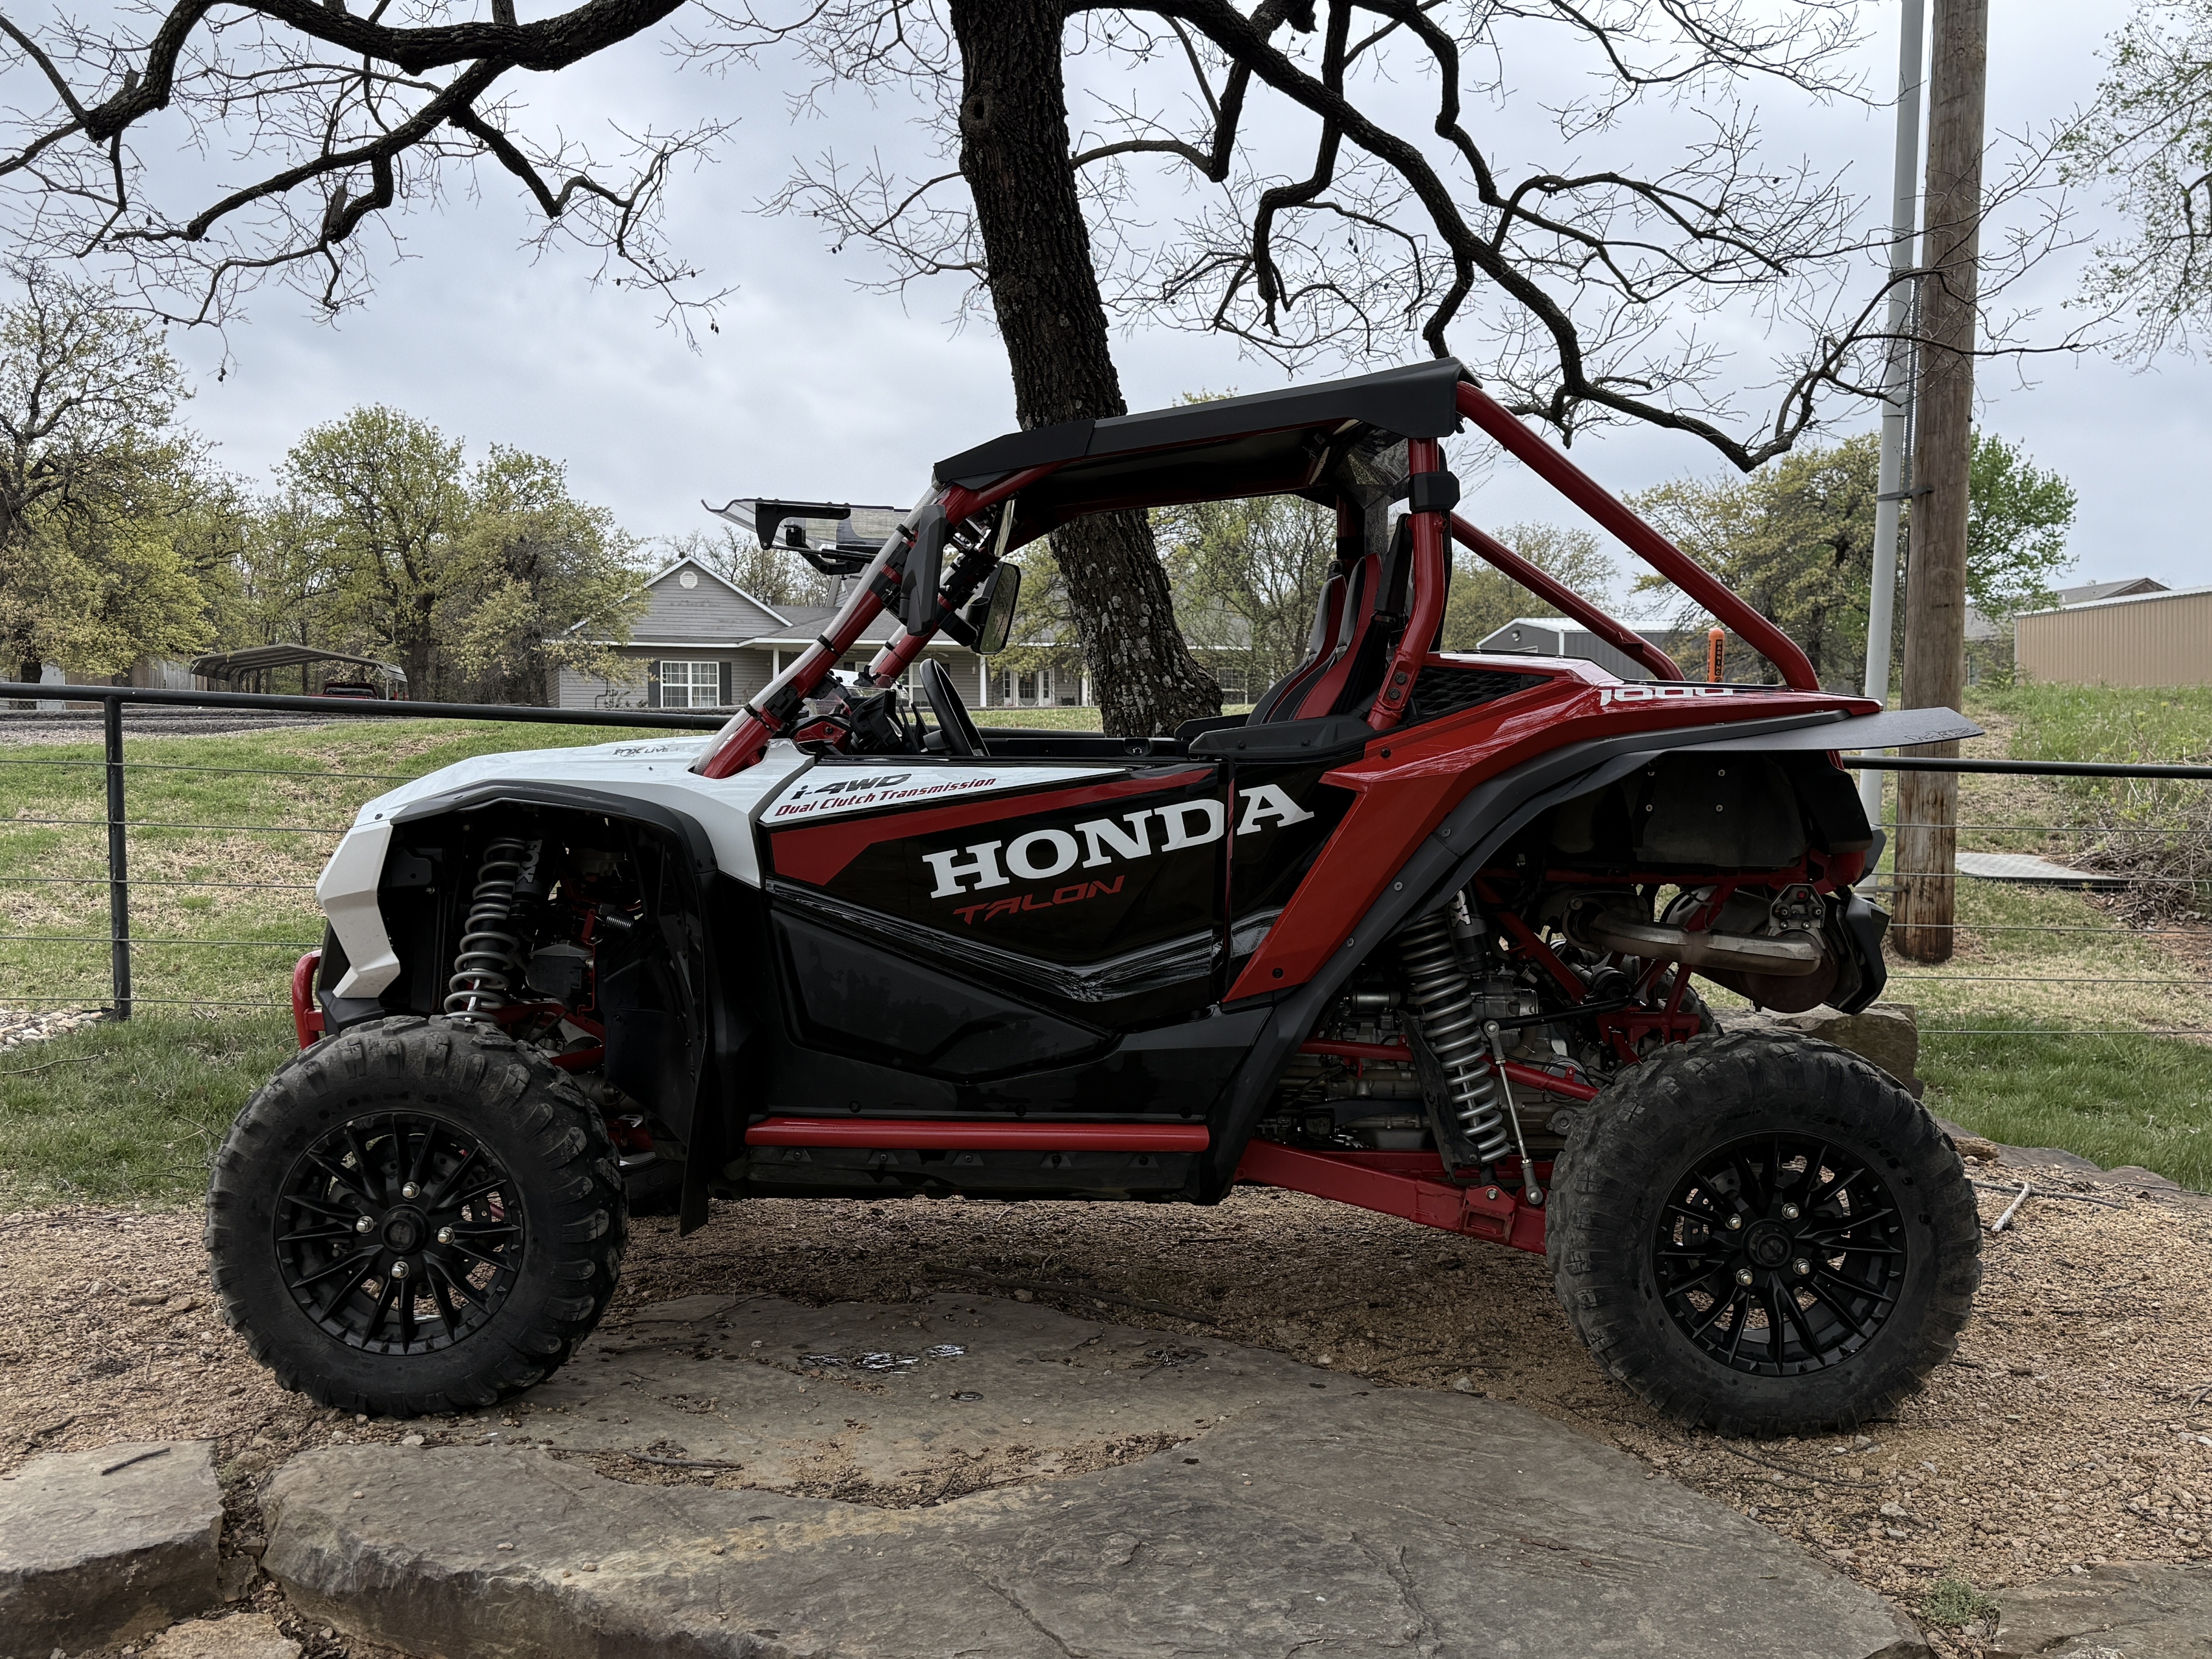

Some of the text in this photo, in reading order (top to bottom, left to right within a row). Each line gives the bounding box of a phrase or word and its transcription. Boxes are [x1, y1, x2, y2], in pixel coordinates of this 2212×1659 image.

[774, 778, 997, 816] Dual Clutch Transmission
[516, 839, 543, 883] FOX
[922, 784, 1314, 898] HONDA
[953, 874, 1125, 925] TALON
[1447, 890, 1471, 927] OX
